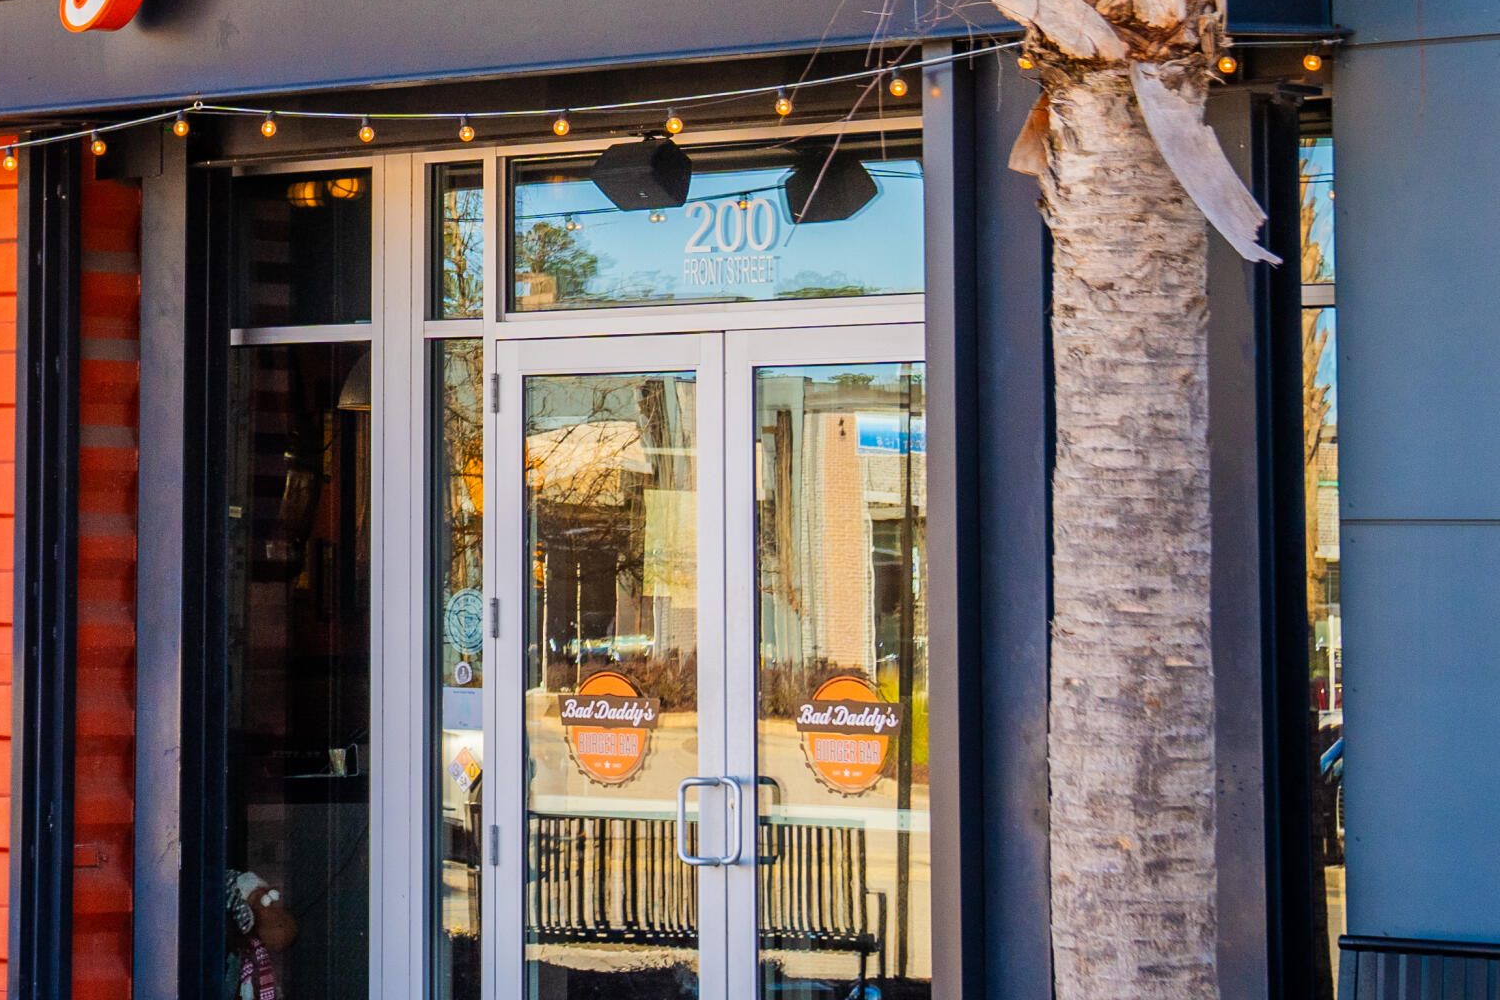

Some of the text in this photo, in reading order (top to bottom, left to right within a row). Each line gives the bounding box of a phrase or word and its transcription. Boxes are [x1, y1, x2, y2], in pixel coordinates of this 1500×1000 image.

[684, 198, 775, 253] 200
[683, 255, 775, 286] FRONT STREET
[562, 699, 655, 727] Bad Daddy's
[796, 704, 899, 733] Bad Daddy's
[578, 732, 639, 757] BURGER BAR
[814, 738, 881, 765] BURGER BAR
